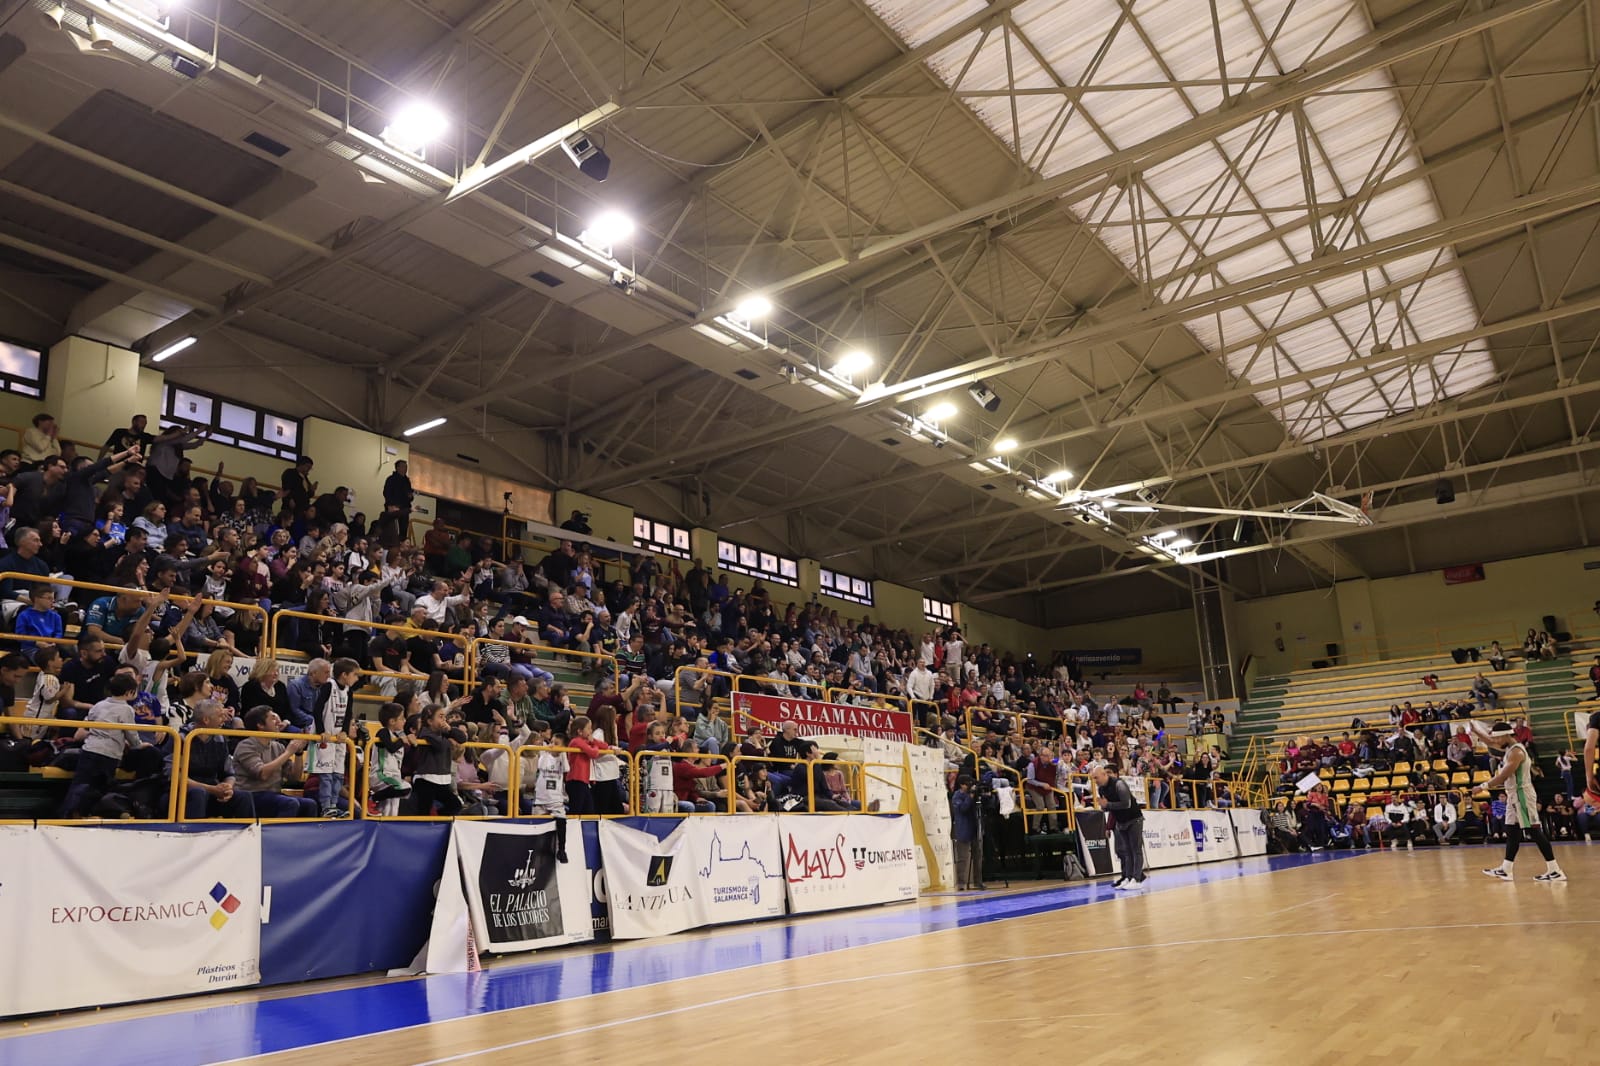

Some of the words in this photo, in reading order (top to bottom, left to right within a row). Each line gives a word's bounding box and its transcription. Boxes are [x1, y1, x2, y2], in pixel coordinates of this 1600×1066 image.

[779, 701, 895, 730] SALAMANCA
[868, 848, 914, 864] UNICARNE
[713, 886, 742, 896] TURISMO
[714, 893, 748, 904] SALAMANCA
[490, 893, 502, 913] EL
[505, 889, 548, 912] PALACIO
[51, 900, 208, 924] EXPOCERÁMICA
[492, 913, 503, 928] DE
[504, 911, 518, 928] LOS
[517, 908, 550, 926] LICORES
[196, 963, 237, 975] Plásticos
[208, 973, 238, 984] Durán
